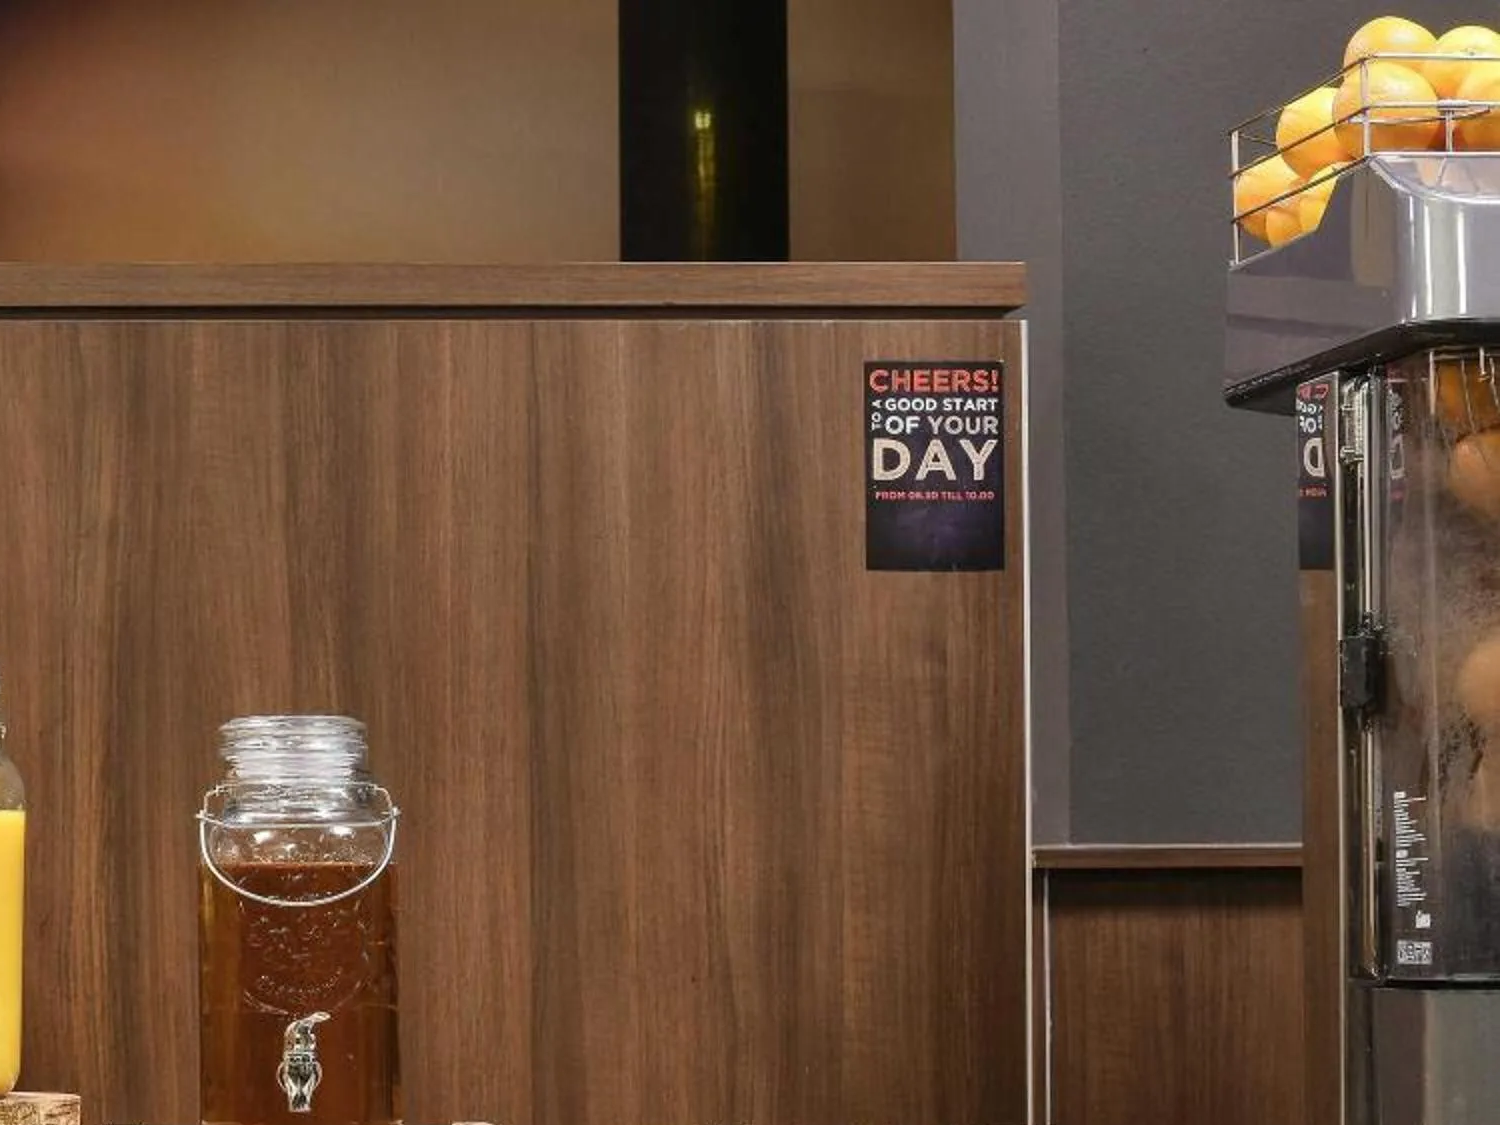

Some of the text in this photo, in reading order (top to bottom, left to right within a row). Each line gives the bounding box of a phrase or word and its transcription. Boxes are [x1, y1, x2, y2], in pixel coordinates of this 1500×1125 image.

[869, 369, 998, 392] CHEERS!
[885, 397, 998, 411] GOOD START
[885, 415, 998, 434] OF YOUR
[873, 438, 998, 481] DAY
[875, 491, 906, 500] FROM
